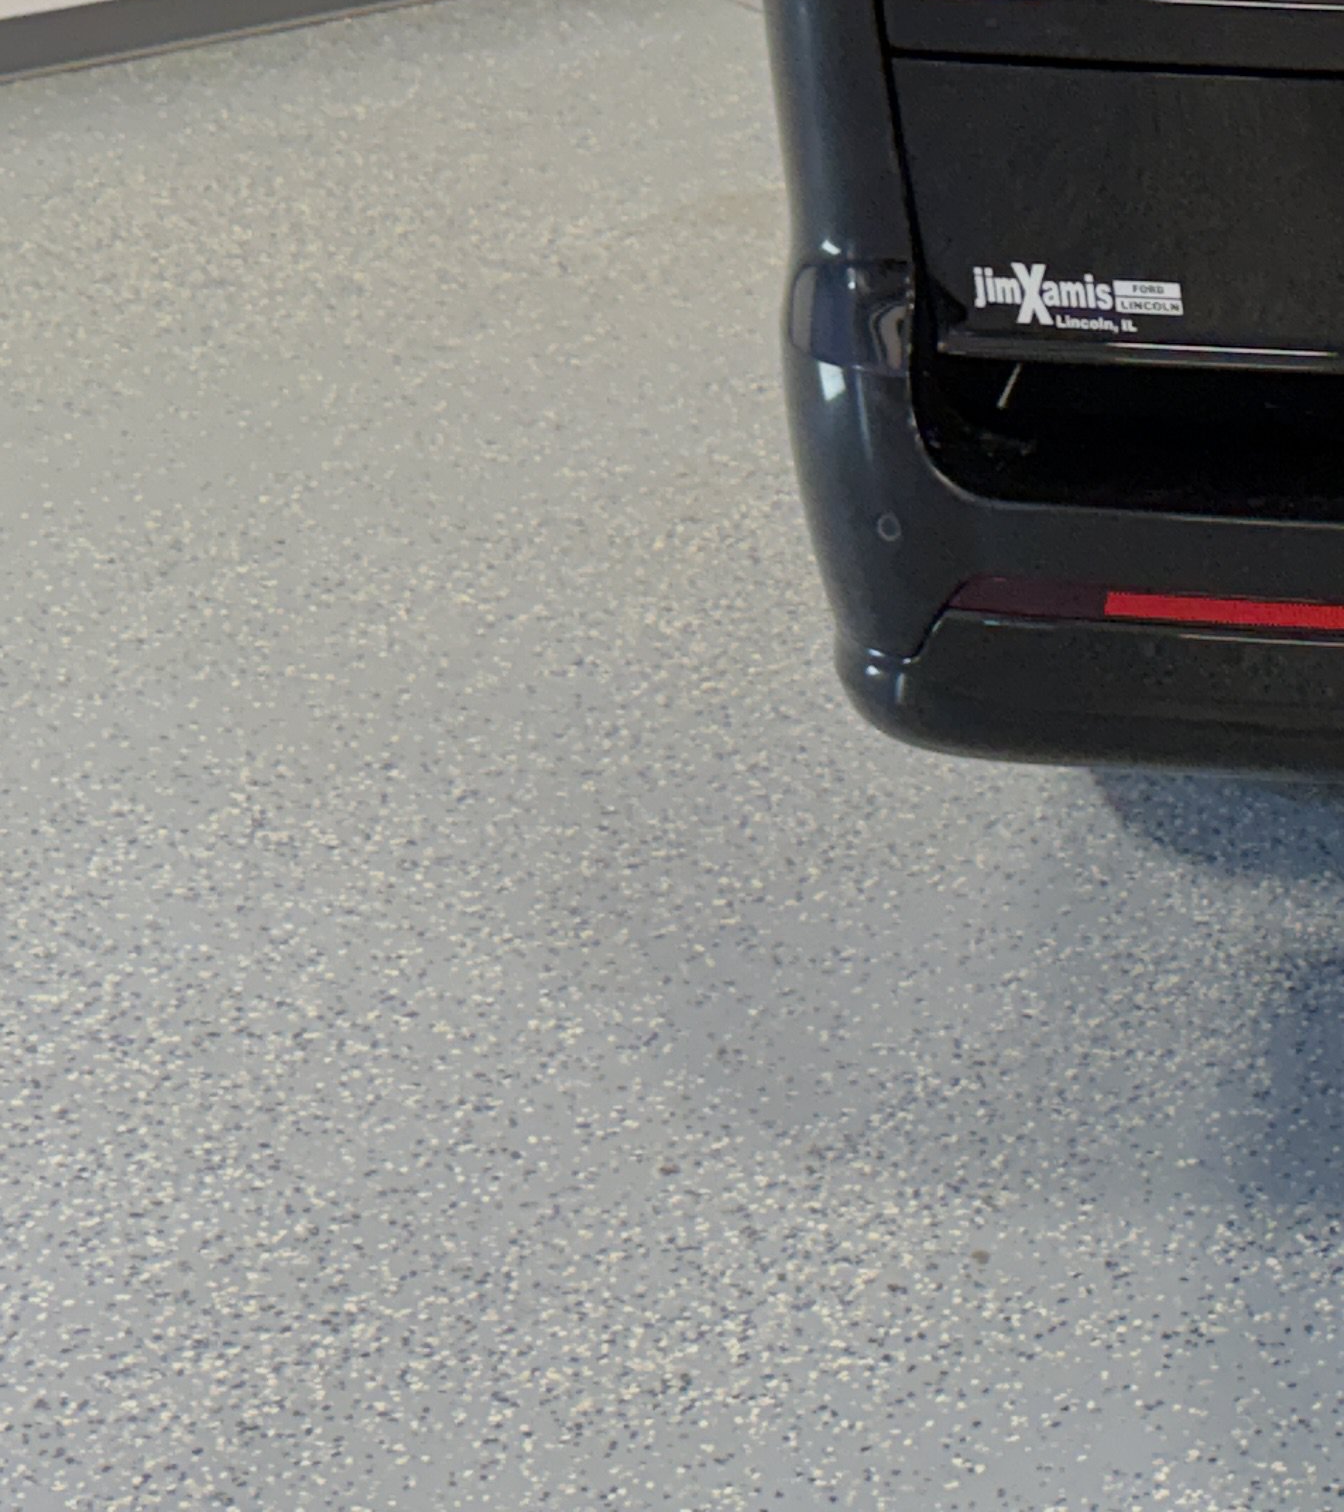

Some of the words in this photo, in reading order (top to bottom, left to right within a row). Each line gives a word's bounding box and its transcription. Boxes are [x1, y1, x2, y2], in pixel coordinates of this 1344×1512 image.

[1132, 283, 1165, 294] FORD
[1121, 300, 1180, 312] LINCOLN
[1056, 315, 1119, 333] Lincoln,
[1122, 320, 1138, 332] IL
